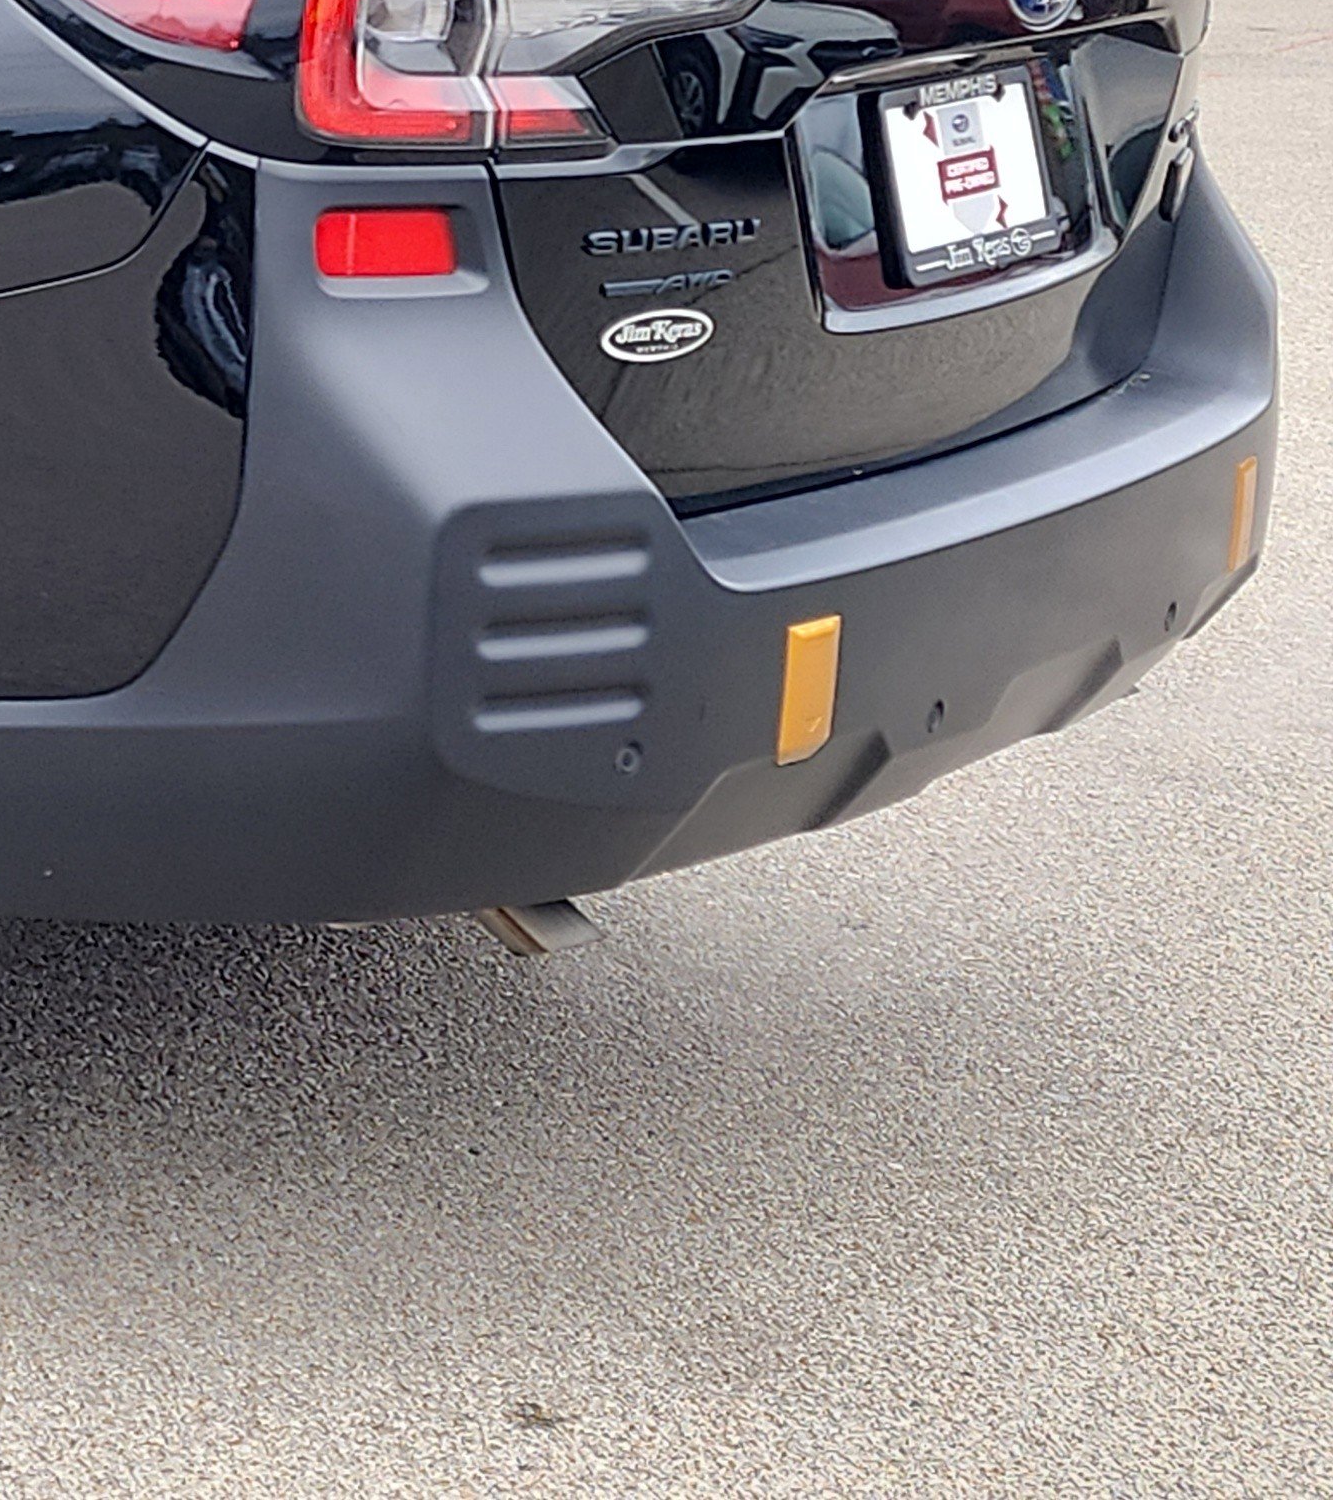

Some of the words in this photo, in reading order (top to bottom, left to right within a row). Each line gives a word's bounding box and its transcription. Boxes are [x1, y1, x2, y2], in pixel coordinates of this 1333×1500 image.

[918, 73, 998, 106] MEMPHIS
[584, 217, 762, 256] SUBARU
[655, 268, 734, 296] AWD
[614, 323, 651, 345] Jim
